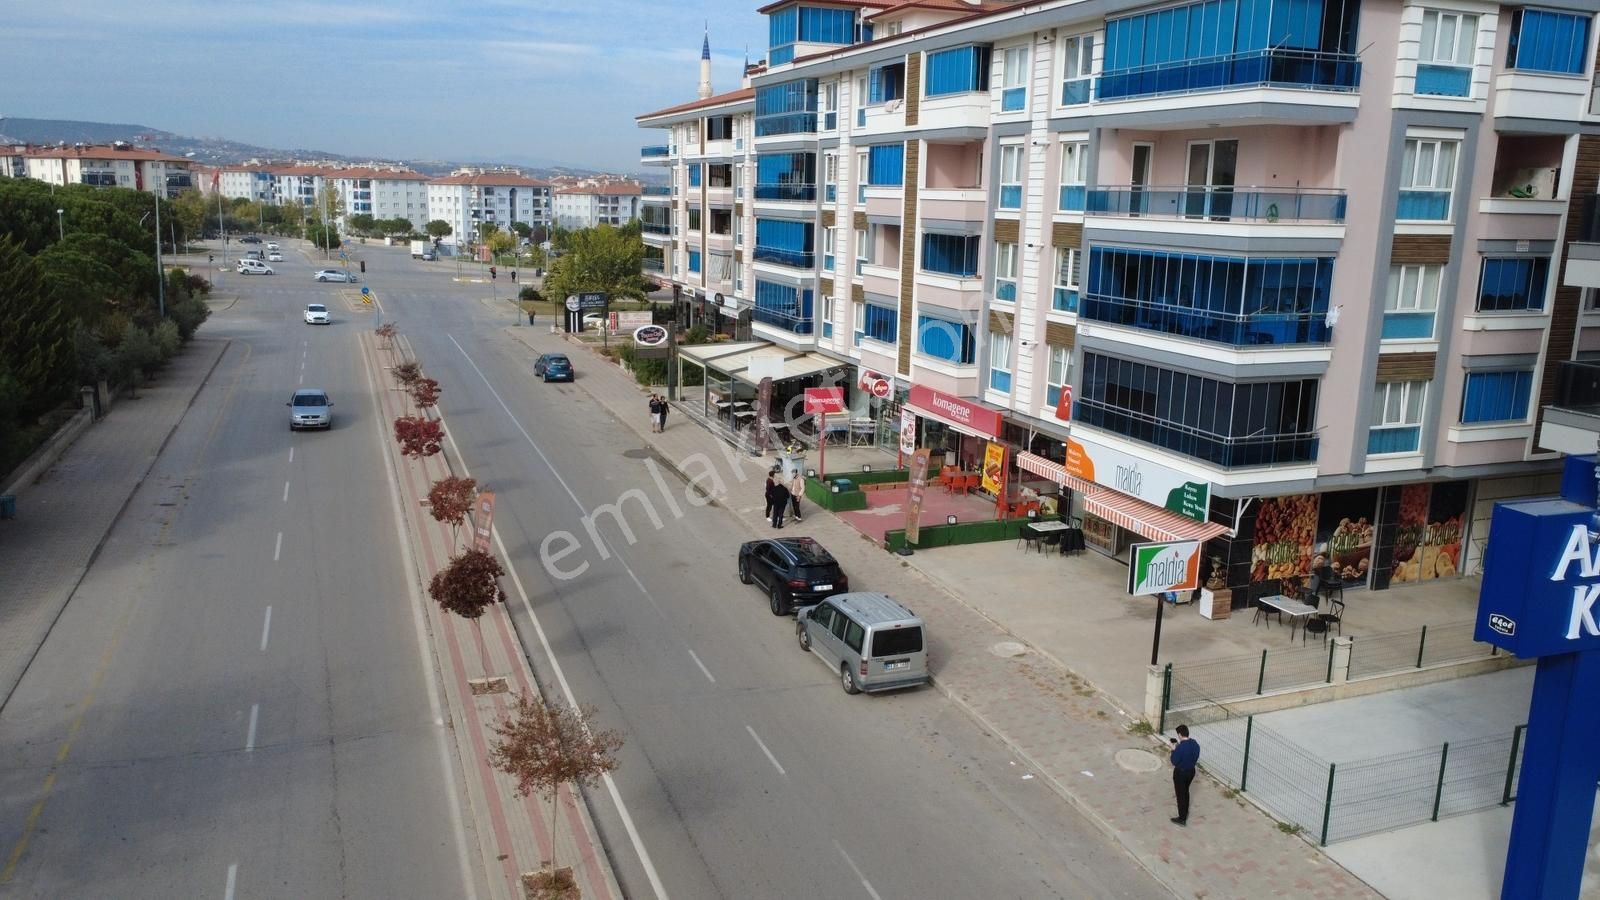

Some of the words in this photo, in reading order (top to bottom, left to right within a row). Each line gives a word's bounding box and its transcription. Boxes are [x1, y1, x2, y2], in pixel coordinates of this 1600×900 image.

[932, 392, 970, 418] komagene
[1115, 463, 1142, 496] maldia
[1146, 551, 1185, 588] maldia
[1550, 524, 1600, 581] A
